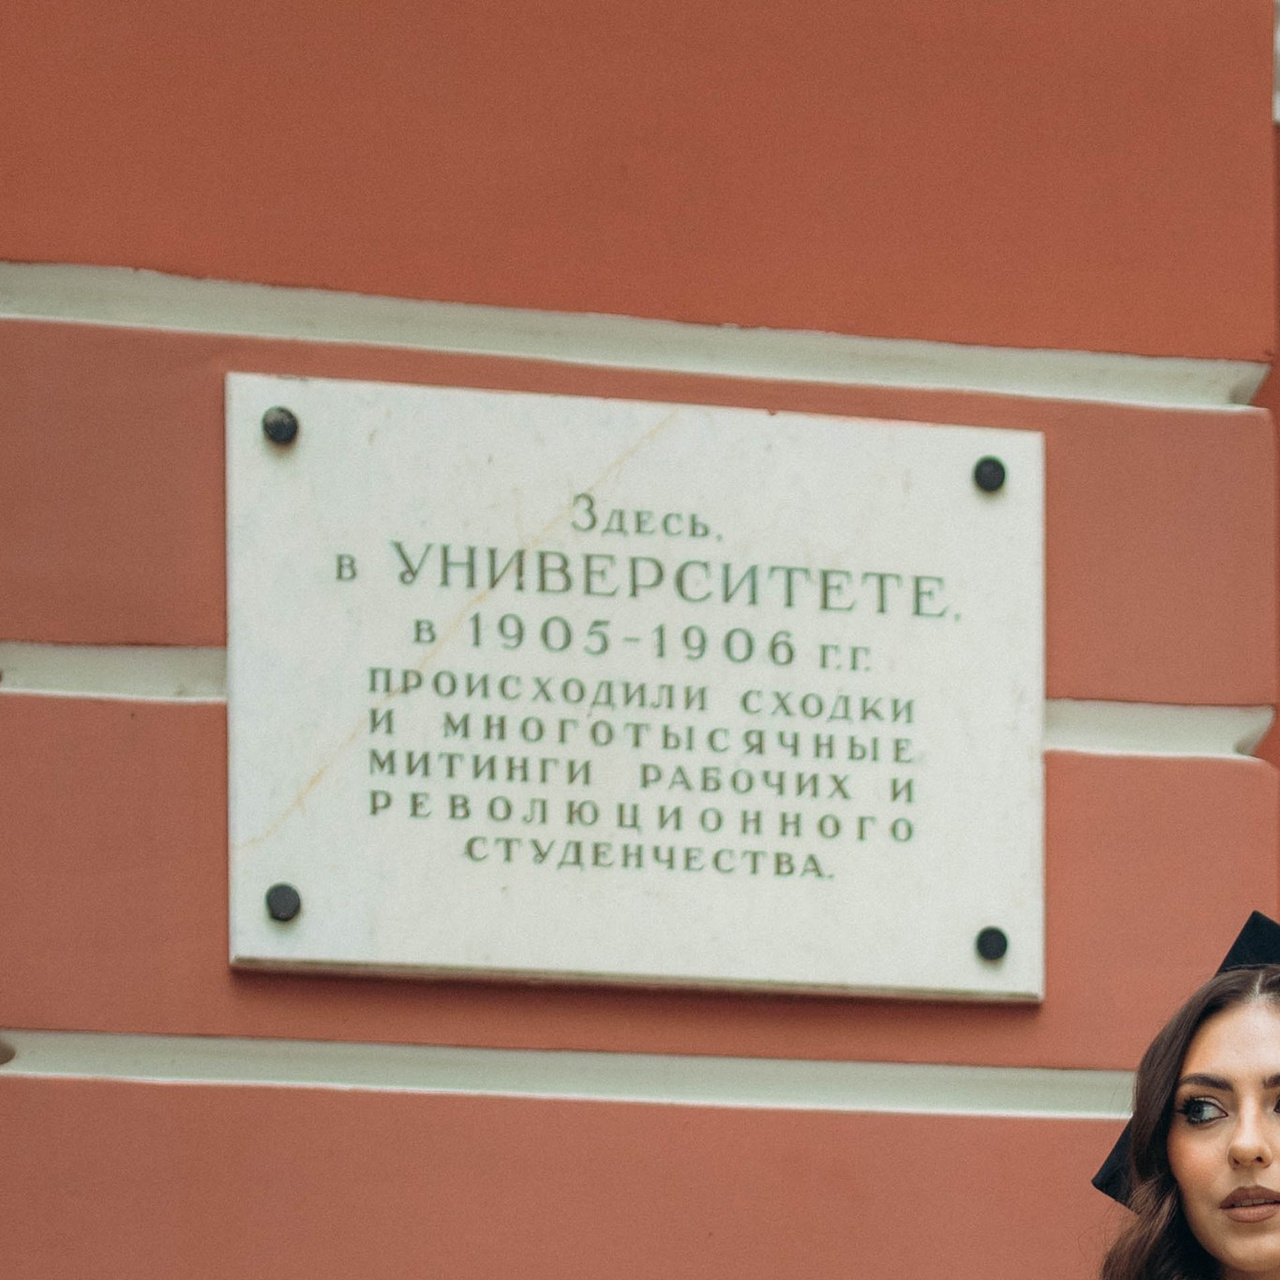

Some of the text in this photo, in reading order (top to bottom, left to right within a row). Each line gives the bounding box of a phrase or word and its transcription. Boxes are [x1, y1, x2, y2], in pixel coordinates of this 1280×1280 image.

[469, 610, 797, 667] 1905-1906
[367, 664, 917, 725] ПРОИСХОДИЛИ СХОДКИ
[367, 706, 915, 764] И МНОГОТЫСЯЧНЫЕ
[367, 747, 916, 804] МИТИНГИ РАБОЧИХ И
[367, 788, 915, 844] РЕВОЛЮЦИОННОГО
